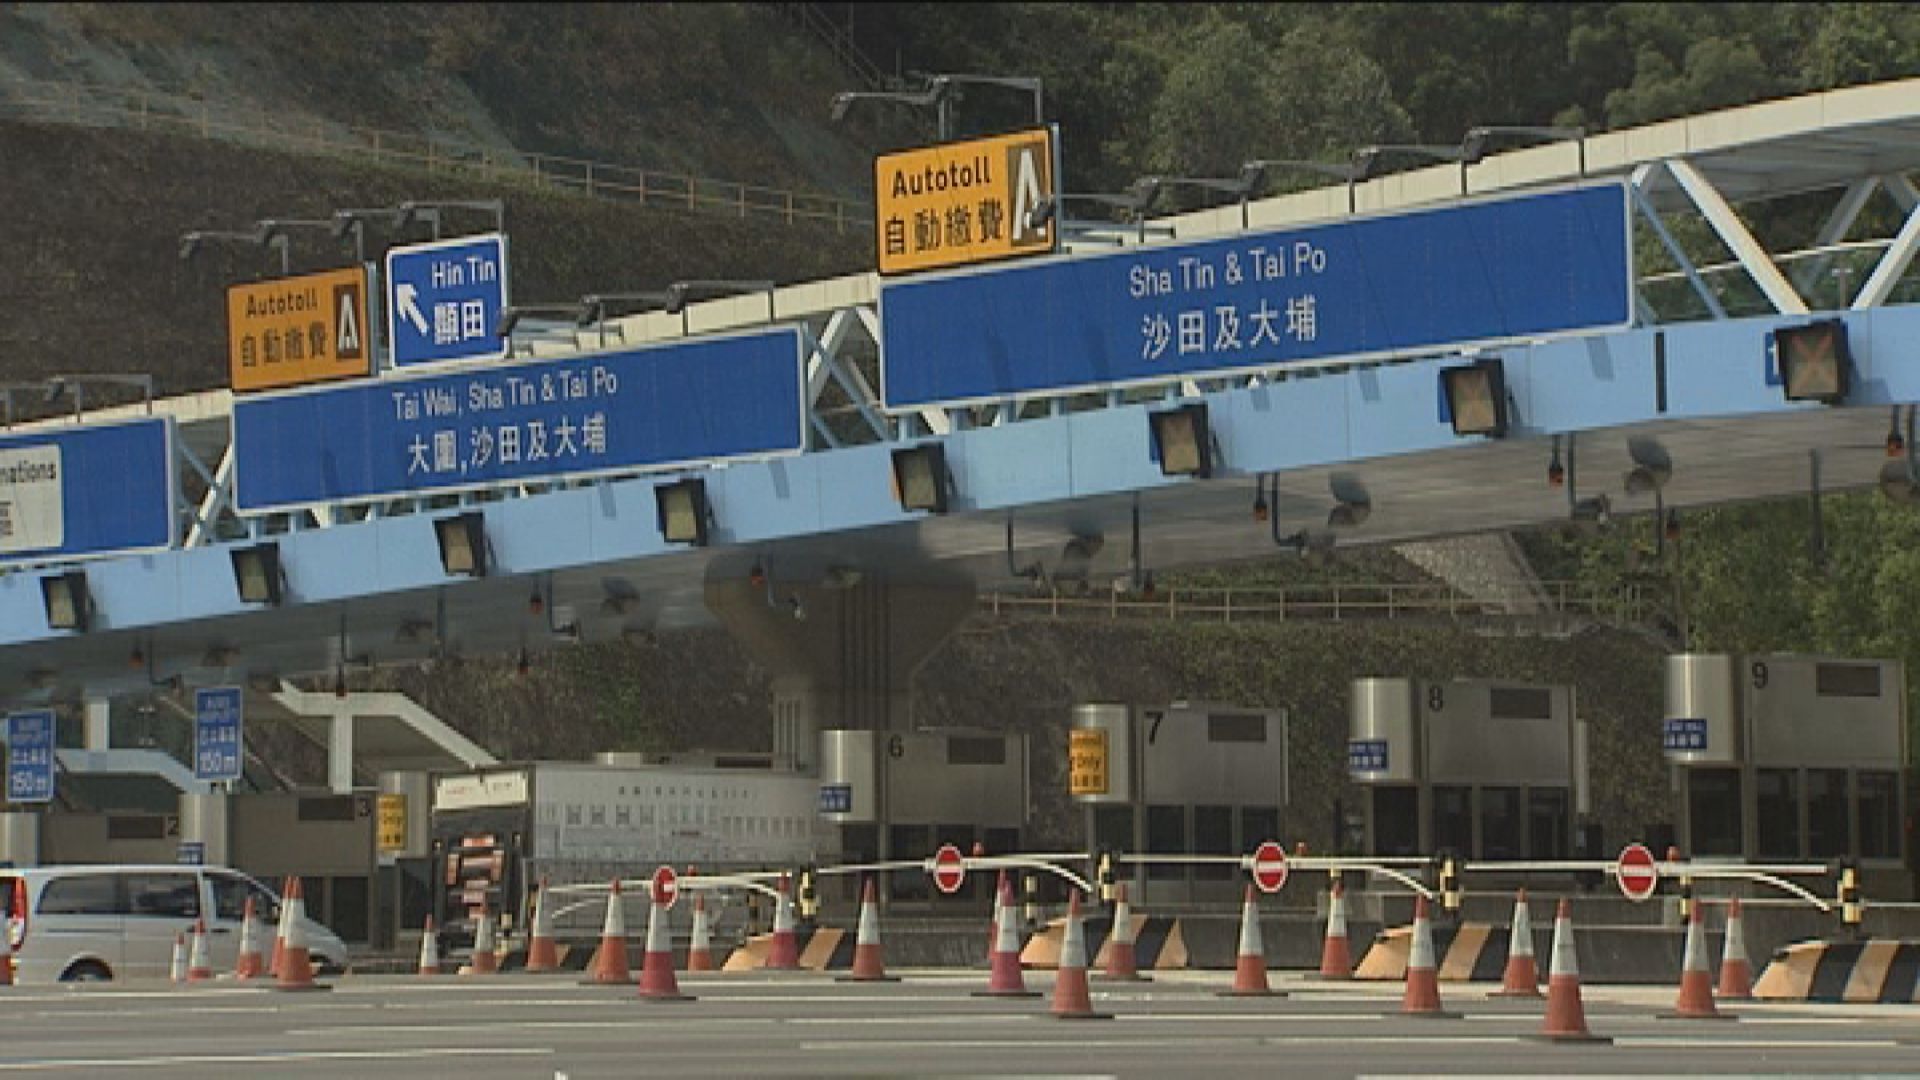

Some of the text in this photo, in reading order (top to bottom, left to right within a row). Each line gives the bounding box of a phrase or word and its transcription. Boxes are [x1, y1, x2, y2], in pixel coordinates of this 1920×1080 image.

[893, 156, 992, 198] Autotoll
[432, 255, 496, 288] Hin Tin
[1130, 242, 1326, 297] Sha Tin & Tai Po
[246, 286, 318, 318] Autotoll
[1142, 294, 1316, 360] 沙田及大埔
[393, 390, 419, 420] Tai
[469, 380, 502, 412] Sha
[506, 377, 536, 405] Tin
[542, 373, 554, 401] &
[560, 369, 588, 400] Tai
[591, 366, 617, 395] Po
[1752, 661, 1768, 689] 9
[1428, 685, 1443, 712] 8
[1144, 710, 1164, 744] 7
[889, 733, 904, 759] 6
